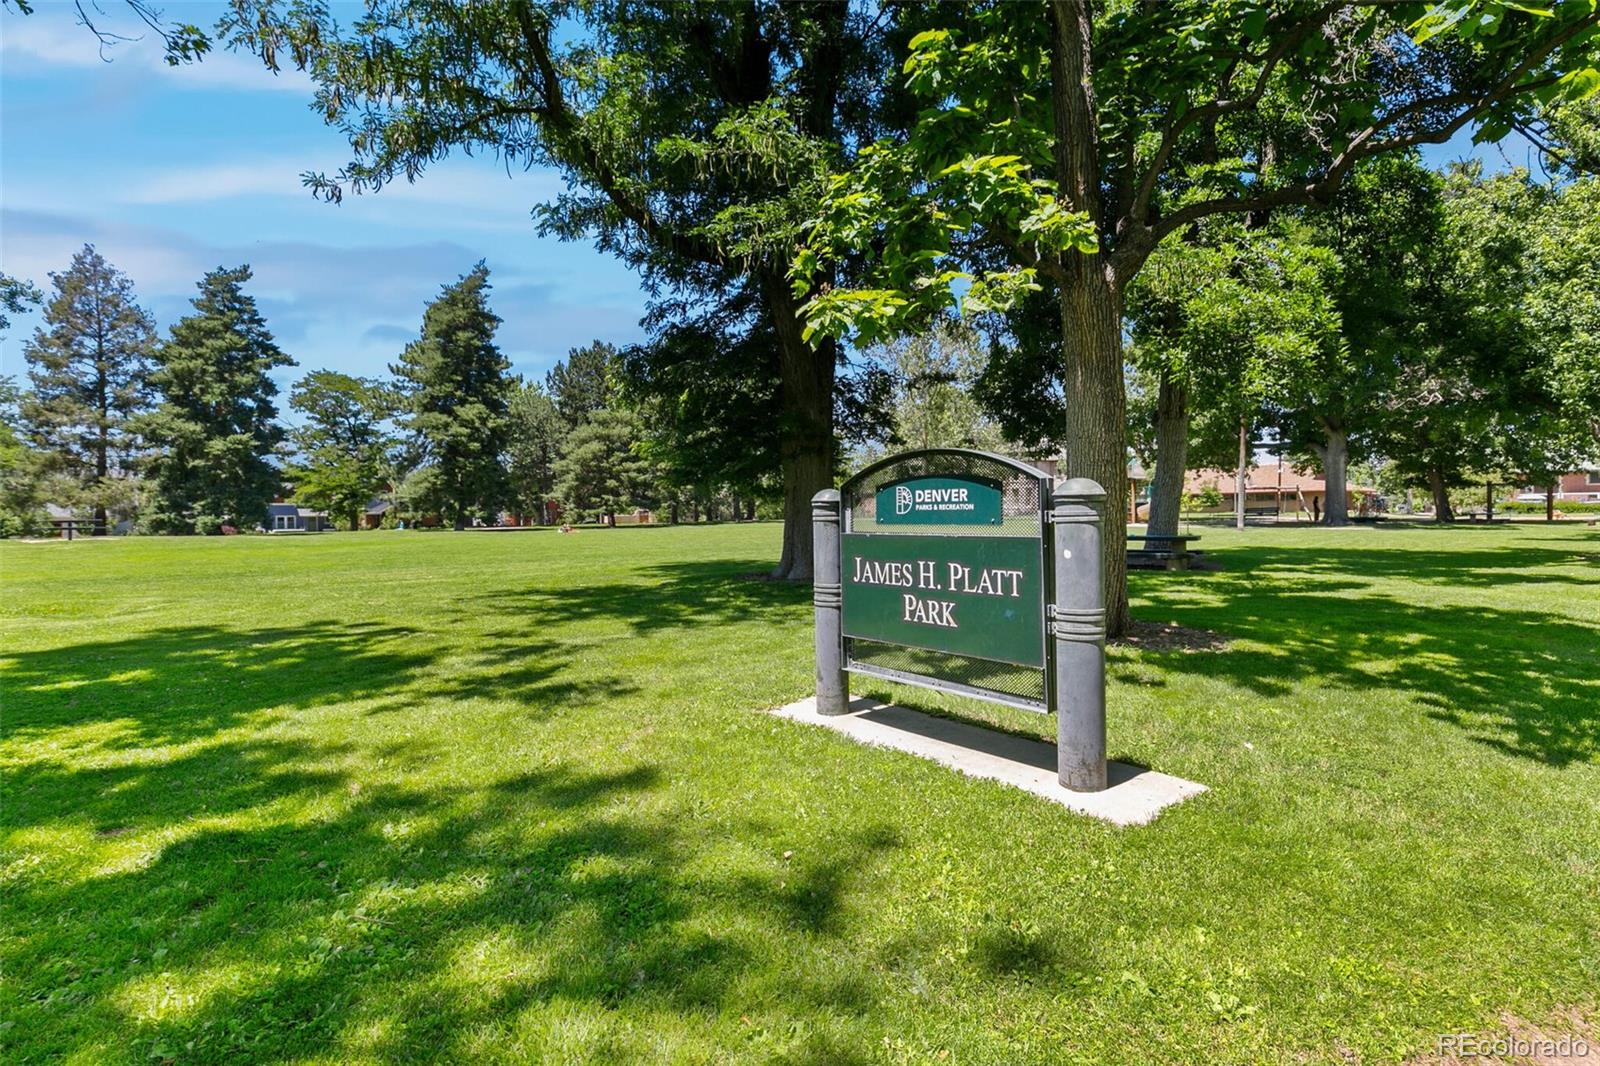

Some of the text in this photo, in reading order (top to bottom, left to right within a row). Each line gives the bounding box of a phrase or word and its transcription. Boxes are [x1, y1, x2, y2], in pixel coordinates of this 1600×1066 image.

[915, 488, 968, 502] DENVER
[939, 503, 974, 511] RECREATION
[853, 557, 1023, 597] JAMES H. PLATT
[903, 594, 958, 628] PARK
